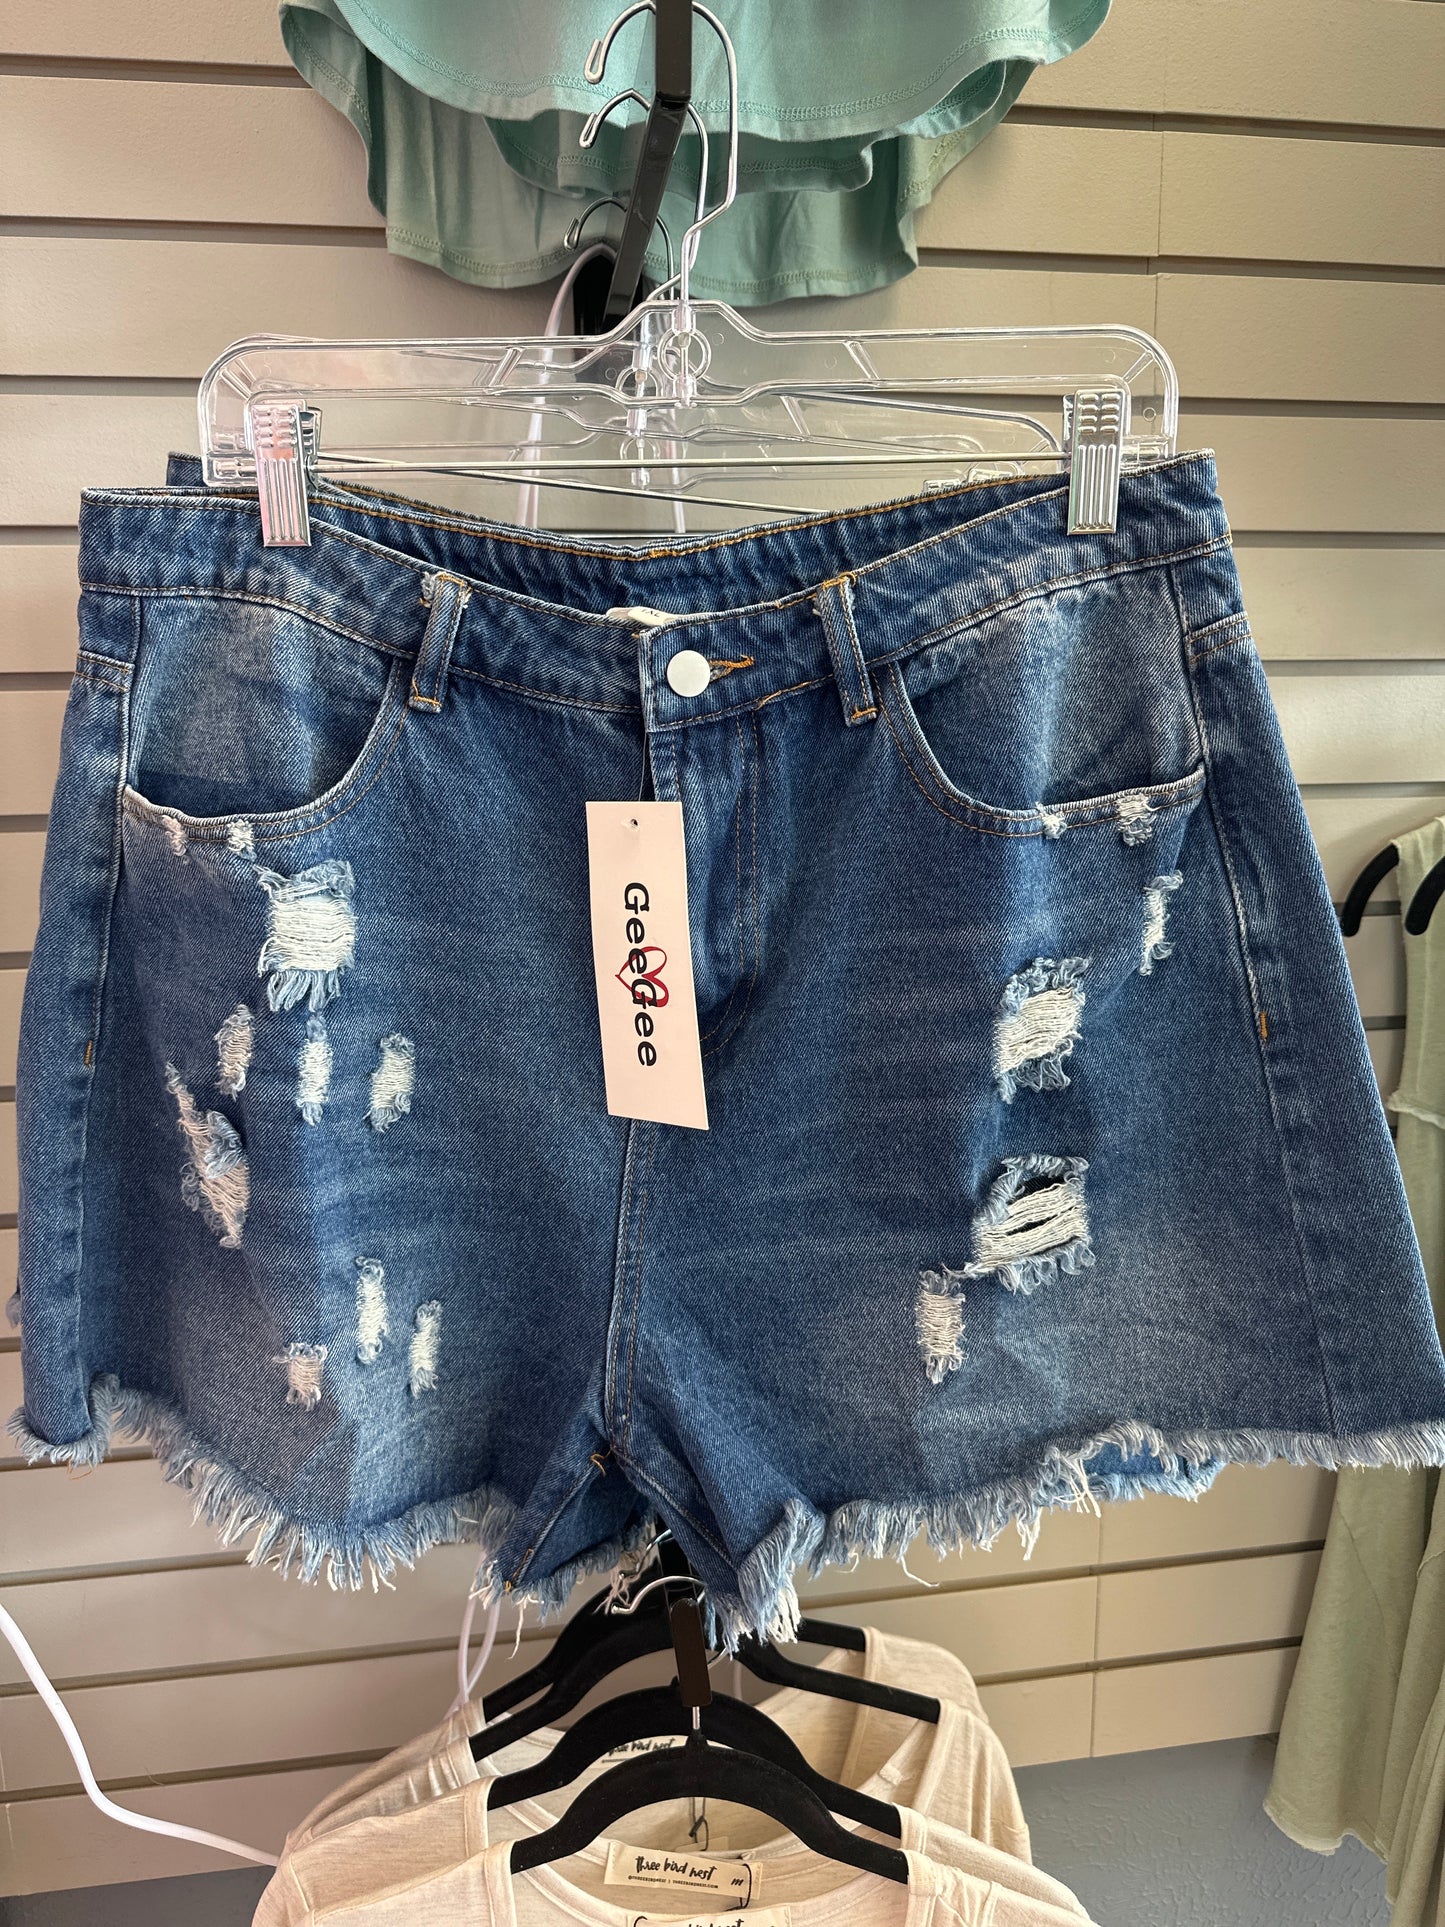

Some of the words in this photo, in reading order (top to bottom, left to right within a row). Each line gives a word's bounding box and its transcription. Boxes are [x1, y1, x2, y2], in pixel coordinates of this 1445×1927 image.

[635, 1855, 661, 1874] three
[663, 1858, 689, 1875] bird
[689, 1865, 718, 1881] nest
